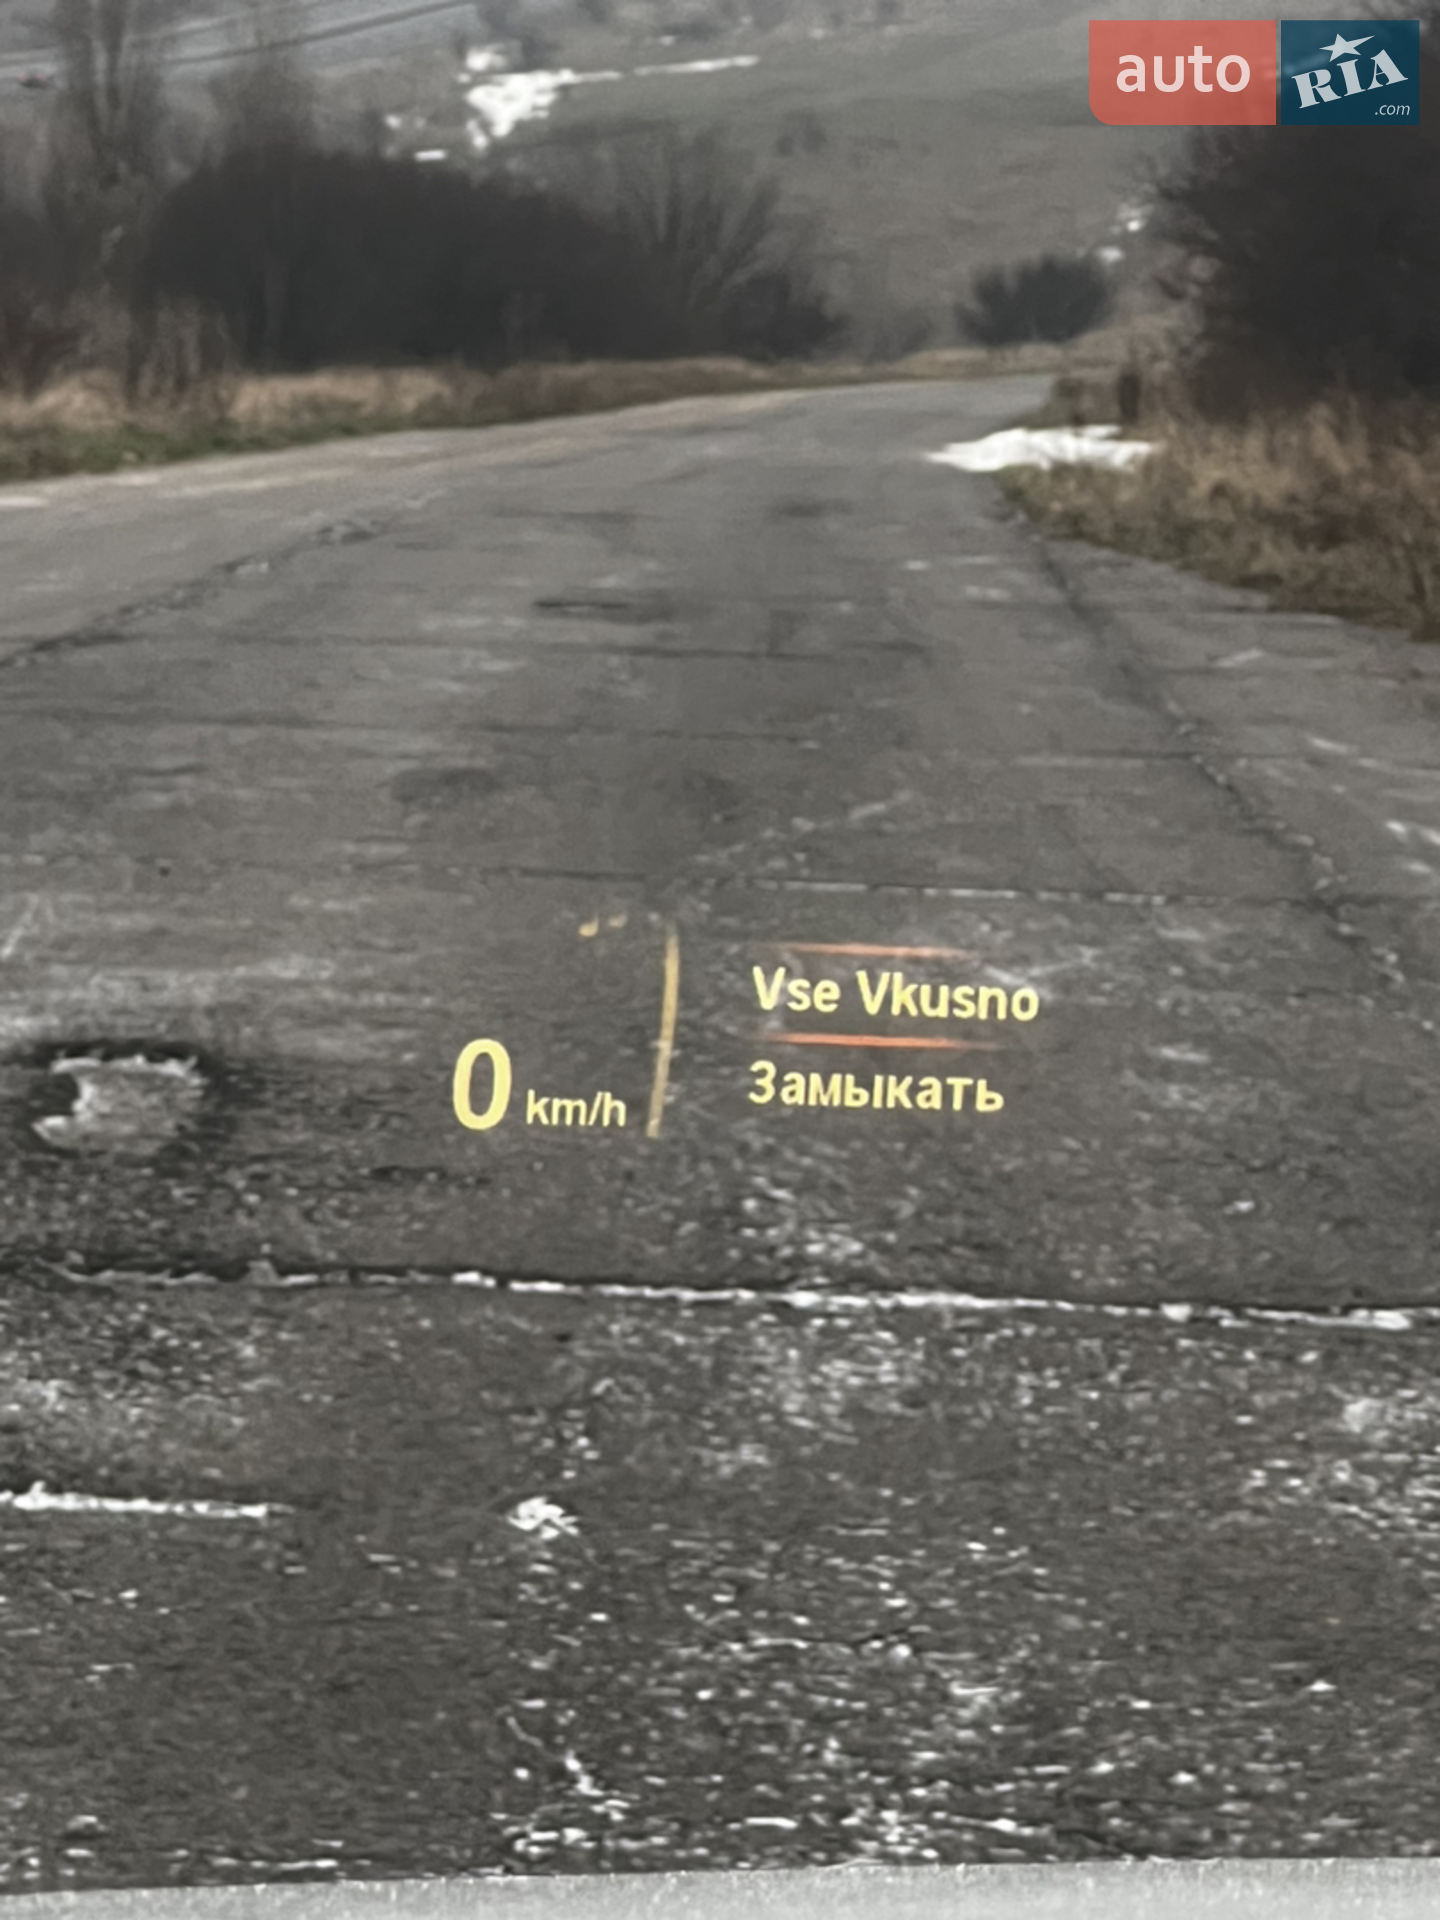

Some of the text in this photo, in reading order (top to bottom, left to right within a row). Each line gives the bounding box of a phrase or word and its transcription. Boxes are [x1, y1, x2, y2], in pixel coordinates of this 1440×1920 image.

[752, 966, 1040, 1021] Vse Vkusno
[453, 1038, 627, 1130] 0 km/h
[748, 1060, 1005, 1112] Замыкать
